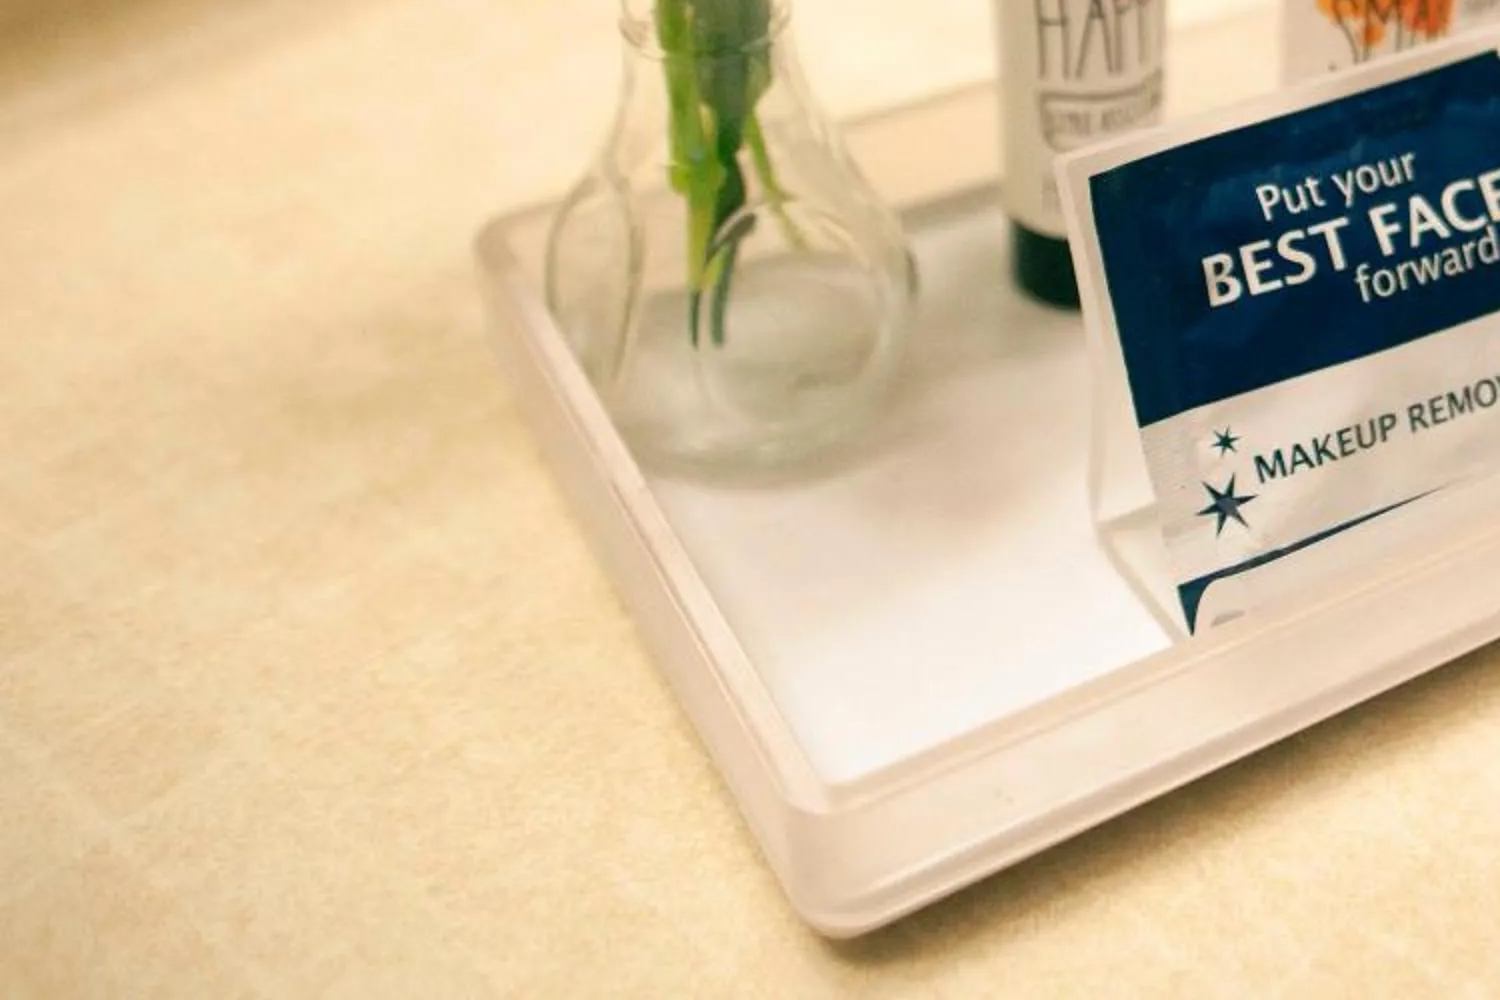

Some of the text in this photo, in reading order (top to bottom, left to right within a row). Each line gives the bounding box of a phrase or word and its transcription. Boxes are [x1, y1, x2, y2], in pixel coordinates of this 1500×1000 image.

[1255, 151, 1416, 221] Put your
[1202, 216, 1349, 308] BEST
[1253, 412, 1399, 485] MAKEUP
